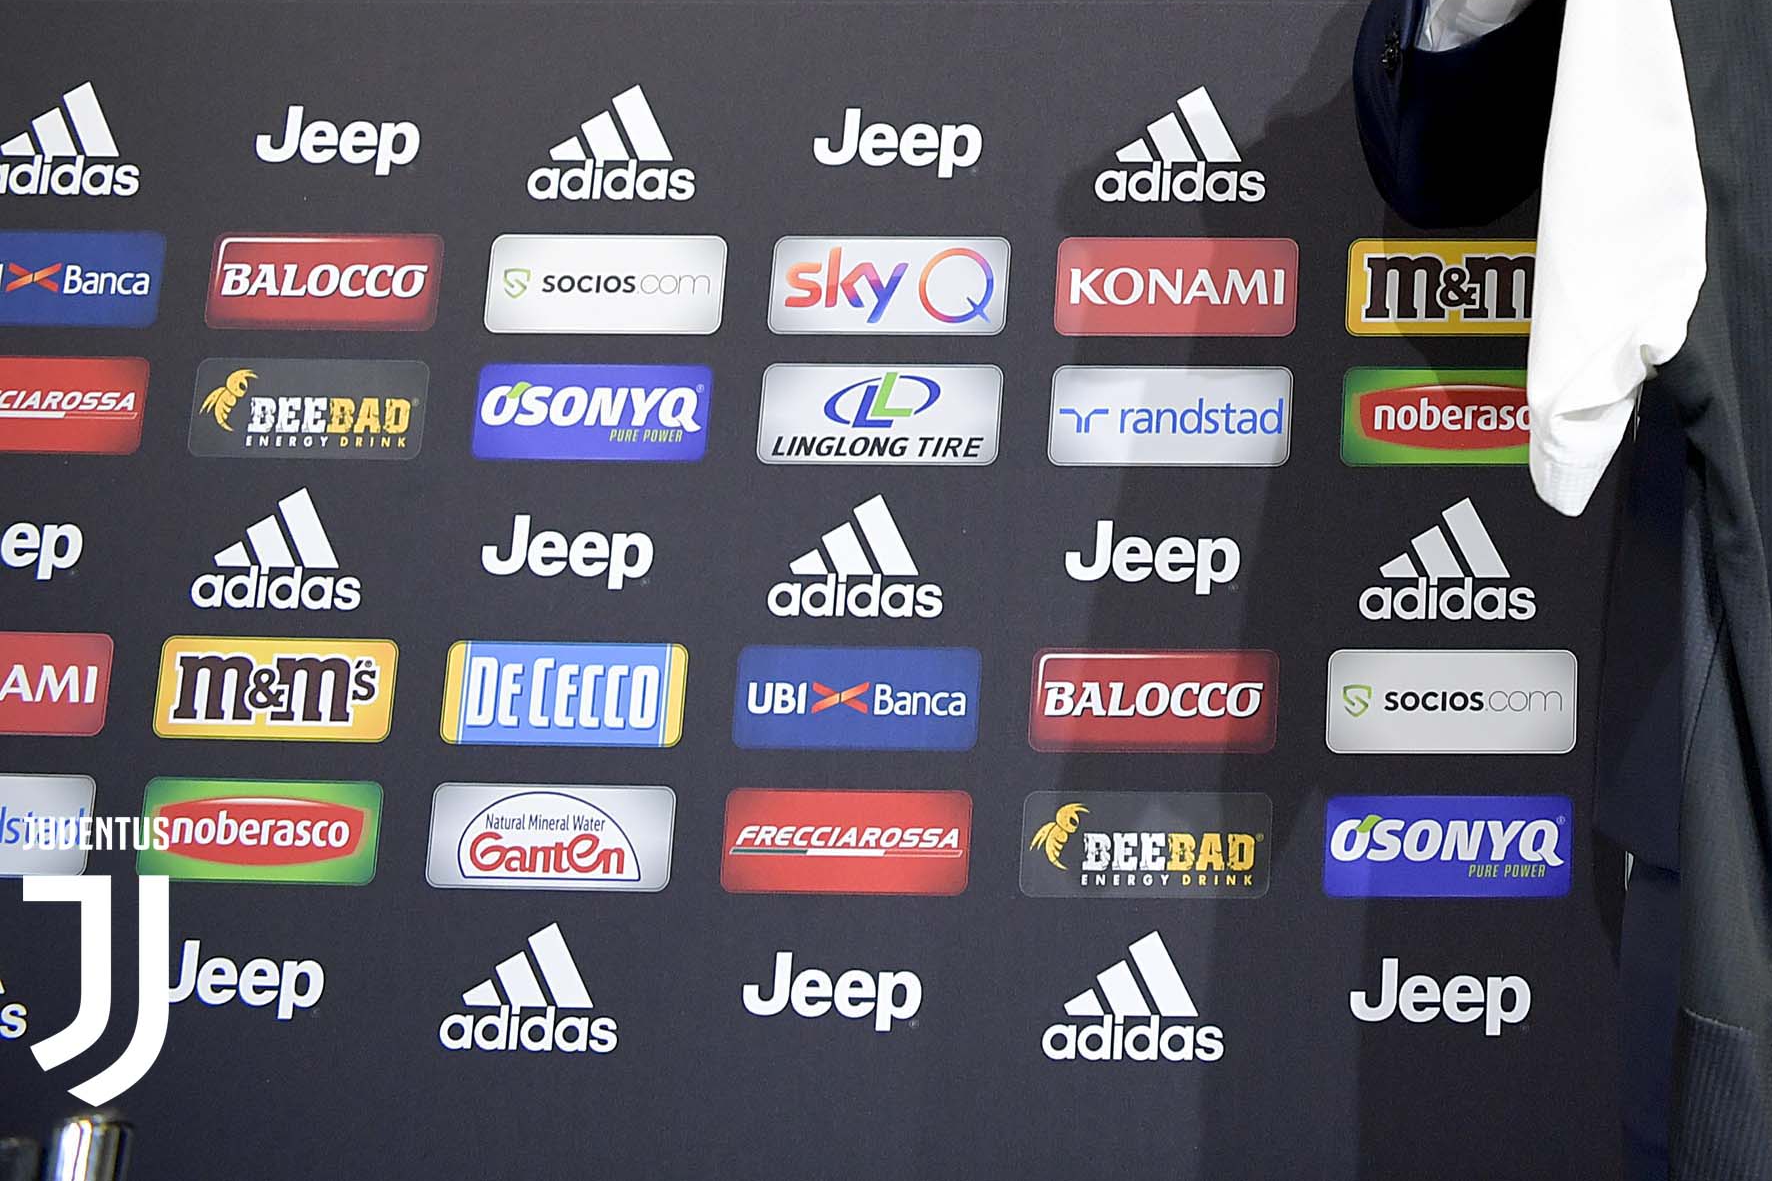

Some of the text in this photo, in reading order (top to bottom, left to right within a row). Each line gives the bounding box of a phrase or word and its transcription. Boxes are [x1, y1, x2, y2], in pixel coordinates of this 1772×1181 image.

[256, 105, 420, 176] Jeep
[813, 107, 983, 178] Jeep
[527, 159, 696, 201] adidas
[1094, 160, 1267, 203] adidas
[63, 265, 150, 295] Banca
[220, 262, 428, 298] BALOCCO
[784, 246, 995, 324] sky Q
[1069, 267, 1286, 306] KONAMI
[1119, 397, 1284, 436] randstad
[1374, 397, 1533, 431] noberasc
[245, 435, 407, 447] ENERGY DRINK
[609, 429, 683, 443] PURE POWER
[771, 435, 984, 458] LINGLONG TIRE
[481, 514, 654, 589] Jeep
[1064, 520, 1240, 594] Jeep
[190, 566, 362, 610] adidas
[766, 573, 943, 618] adidas
[1358, 576, 1537, 620] adidas
[465, 656, 658, 729] DE CECCO
[746, 681, 966, 716] UBI Banca
[1043, 681, 1263, 717] BALOCCO
[171, 809, 350, 848] noberasco
[485, 813, 605, 832] Natural Mineral Water
[736, 825, 960, 848] FRECCIAROSSA
[1081, 874, 1253, 886] ENERGY DRINK
[1468, 864, 1546, 877] PURE POWER
[168, 940, 324, 1019] Jeep
[742, 951, 923, 1032] Jeep
[1349, 957, 1532, 1037] Jeep
[438, 1005, 618, 1053] adidas
[1041, 1014, 1225, 1062] adidas
